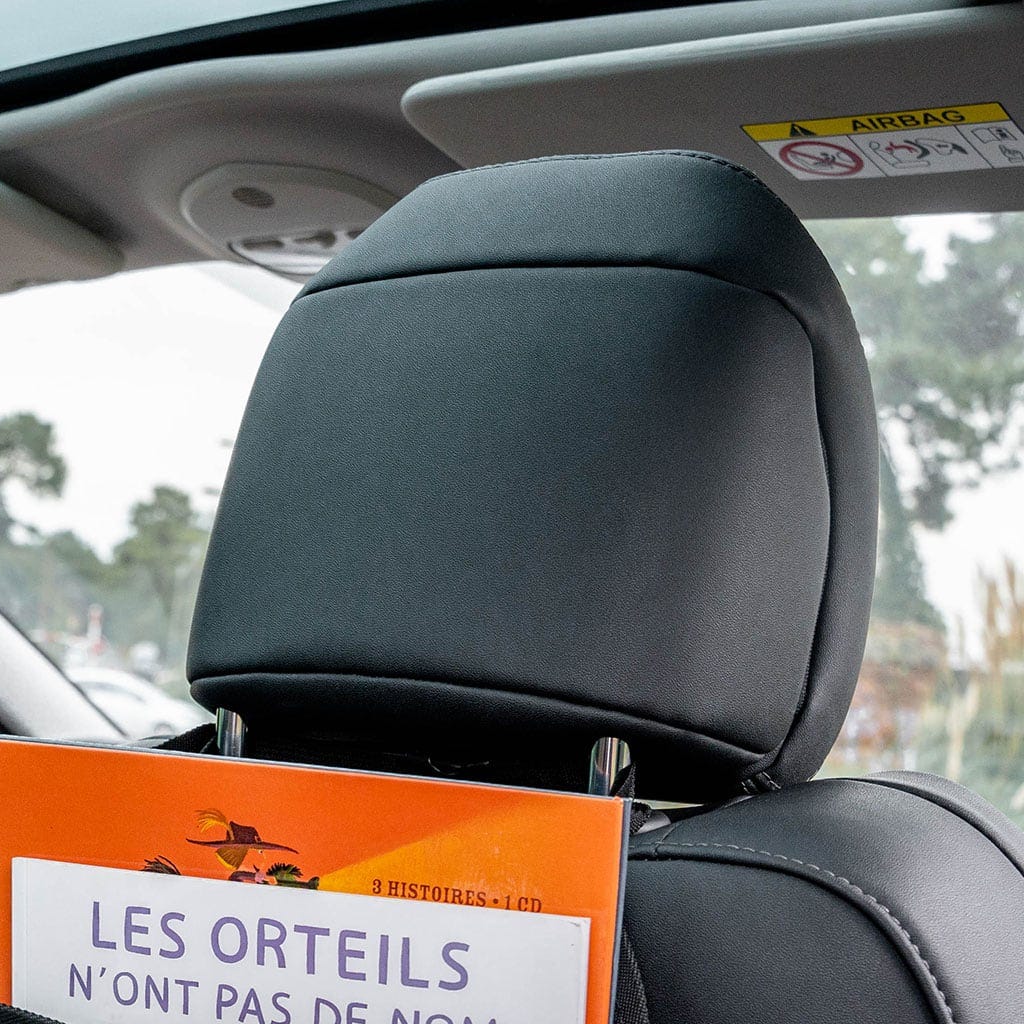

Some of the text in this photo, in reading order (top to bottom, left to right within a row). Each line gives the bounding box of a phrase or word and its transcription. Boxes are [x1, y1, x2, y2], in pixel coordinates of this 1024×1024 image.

[851, 110, 966, 132] AIRBAG
[372, 878, 543, 914] 3 HISTOIRES 1 CD
[91, 900, 471, 992] LES ORTEILS
[68, 962, 200, 1016] N'ONT
